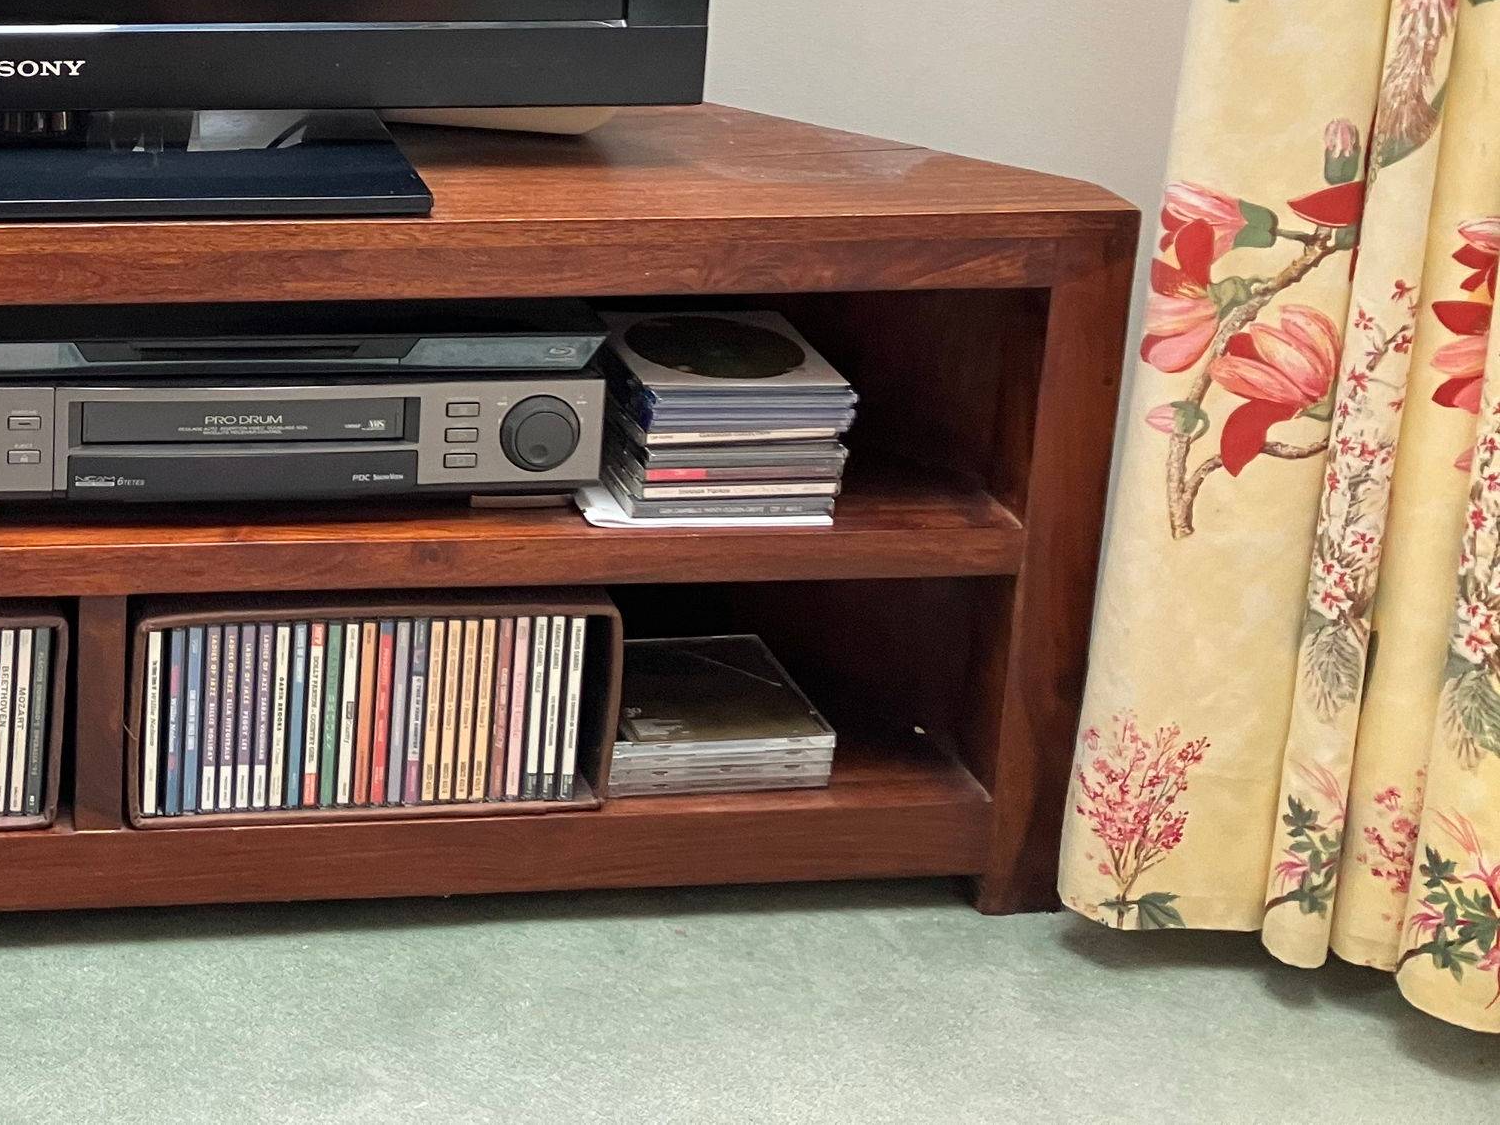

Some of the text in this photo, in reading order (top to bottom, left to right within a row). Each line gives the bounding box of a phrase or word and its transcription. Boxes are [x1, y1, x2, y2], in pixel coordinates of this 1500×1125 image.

[204, 415, 284, 425] PRO DRUM
[0, 666, 9, 728] BEETHOVEN
[16, 687, 26, 730] MOZART
